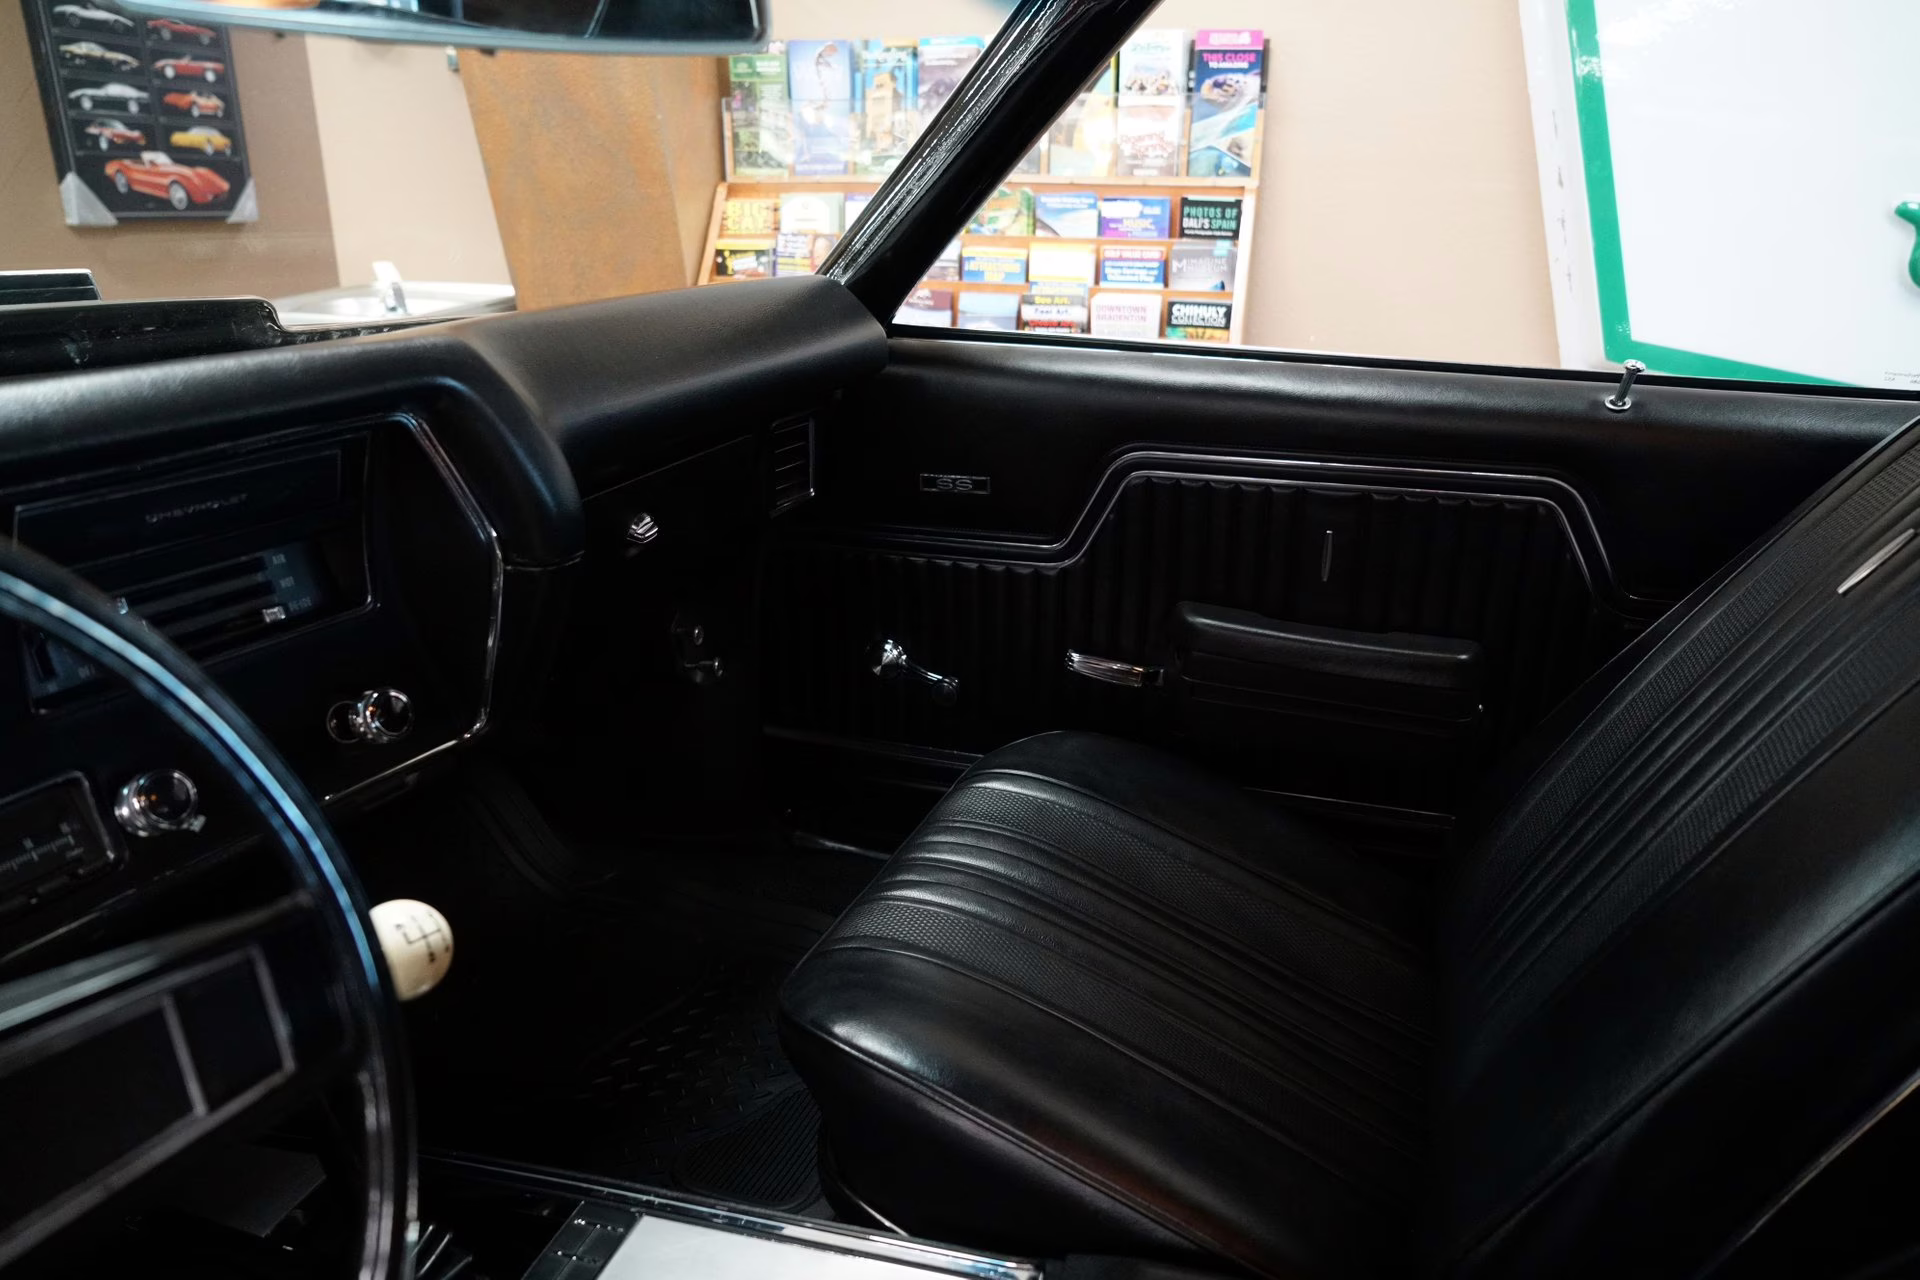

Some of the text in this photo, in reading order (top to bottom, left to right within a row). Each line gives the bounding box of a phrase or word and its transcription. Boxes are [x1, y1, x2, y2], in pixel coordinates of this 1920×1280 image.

[1203, 53, 1256, 62] THIS CLOSE
[727, 200, 769, 217] BIG
[1183, 206, 1239, 219] PHOTOS OF
[1211, 219, 1236, 231] SPAIN
[1096, 304, 1147, 313] DOWNTOWN
[1171, 315, 1226, 327] COLLECTION
[936, 478, 973, 491] SS
